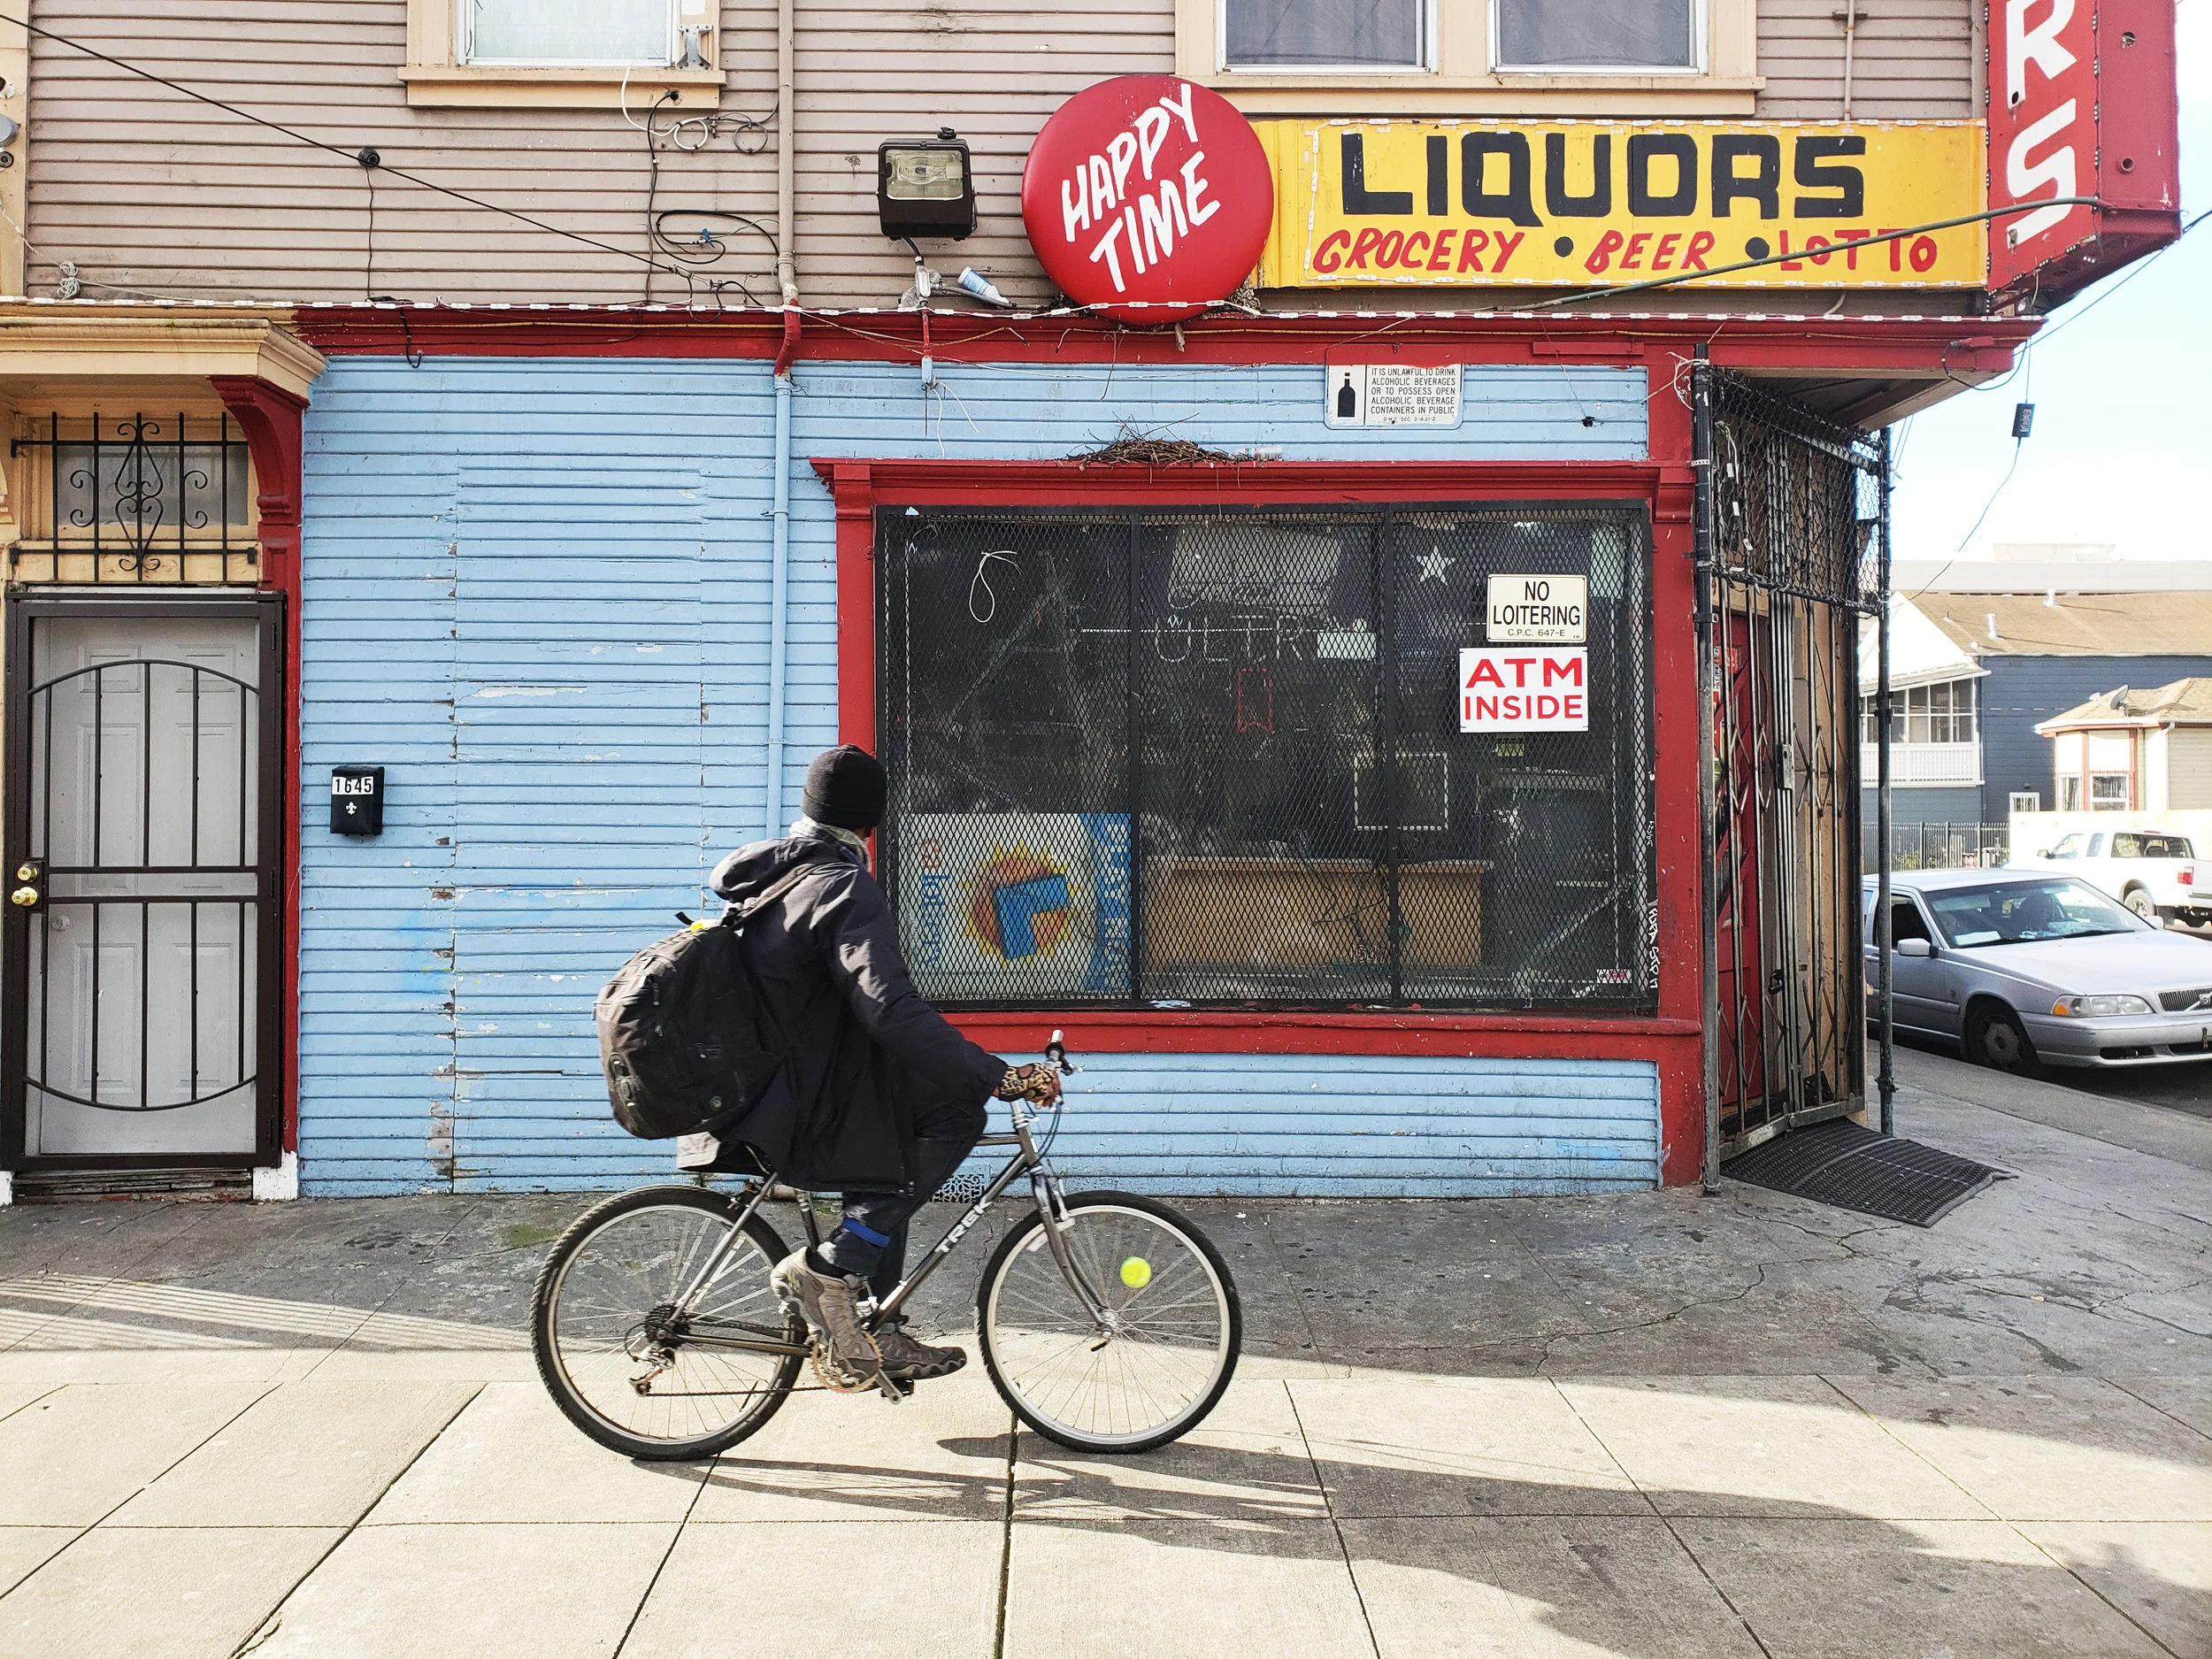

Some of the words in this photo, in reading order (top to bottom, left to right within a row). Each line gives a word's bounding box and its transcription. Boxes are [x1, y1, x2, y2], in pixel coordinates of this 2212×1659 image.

[1062, 84, 1200, 242] HAPPY
[1340, 132, 1866, 227] LIQUORS
[1089, 150, 1221, 293] TIME
[1313, 227, 1525, 274] GROCERY
[1586, 229, 1716, 275] BEER
[1371, 377, 1410, 386] ALCOHOLIC
[1414, 377, 1456, 386] BEVERAGES
[1524, 580, 1550, 602] NO
[1493, 604, 1581, 626] LOITERING
[1507, 628, 1534, 637] C.P.C.
[1538, 628, 1566, 637] 647-E
[1465, 657, 1583, 688] ATM
[1464, 695, 1583, 720] INSIDE
[335, 778, 372, 794] 1645
[934, 1195, 994, 1254] TREK
